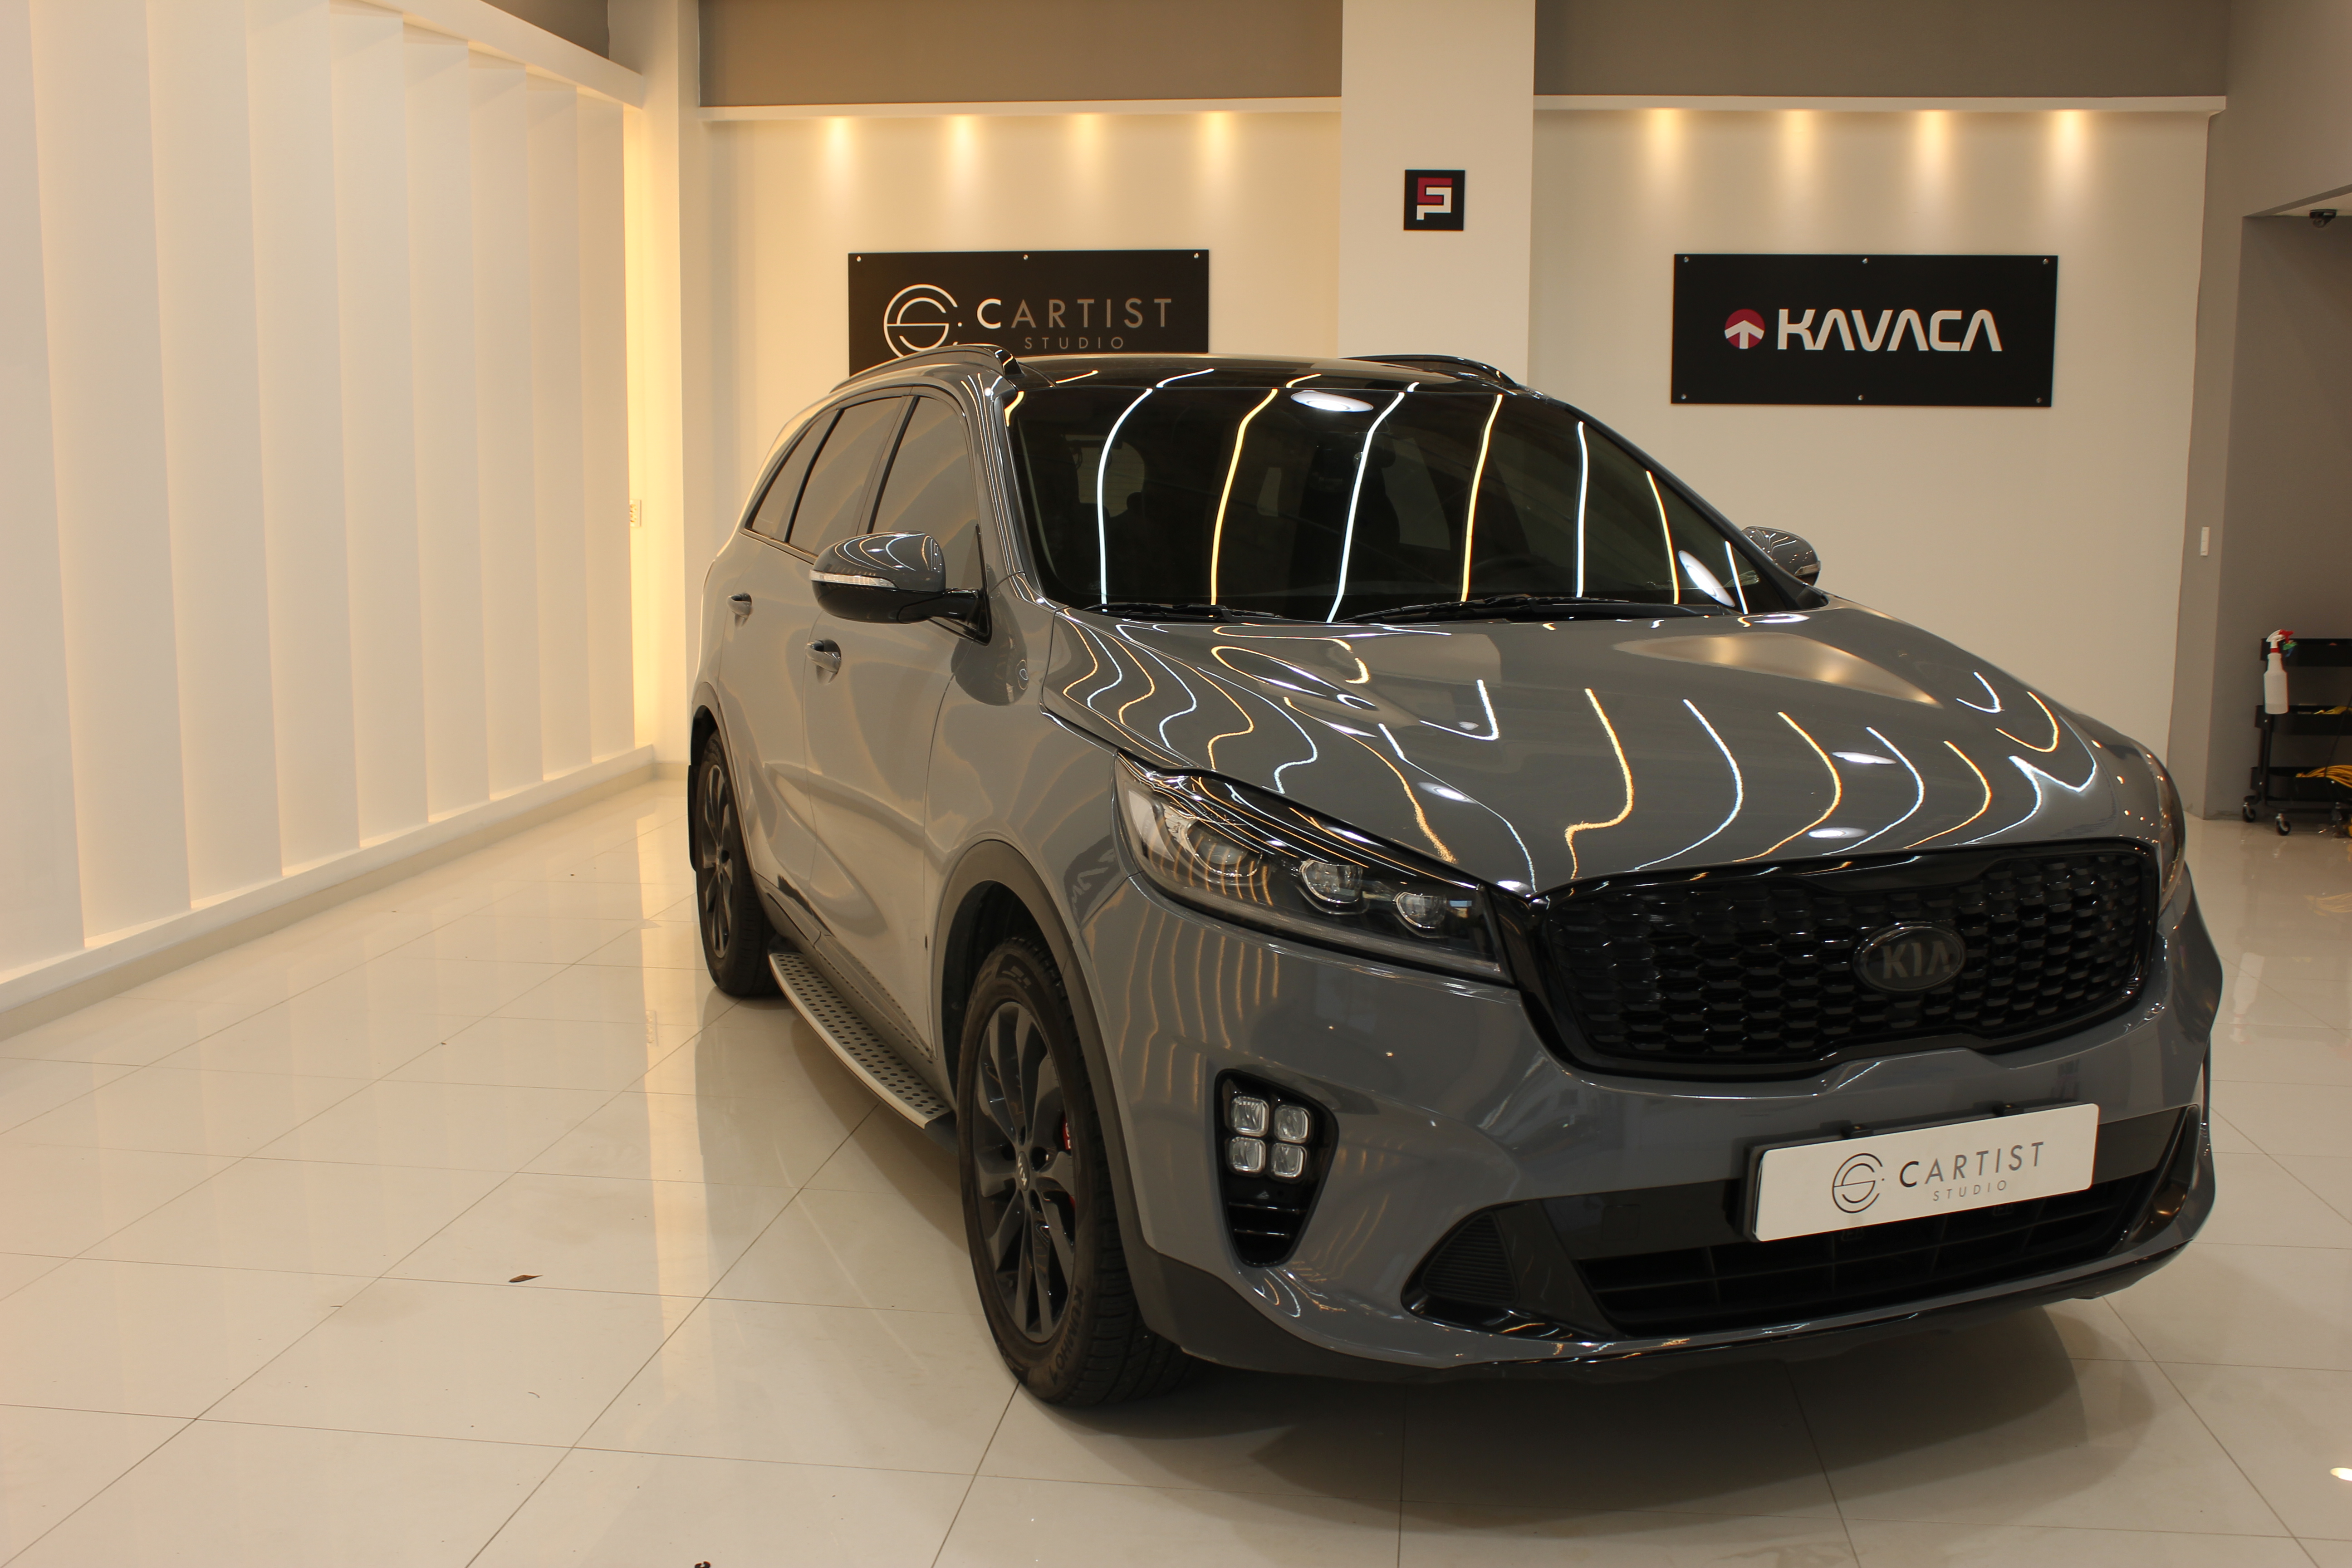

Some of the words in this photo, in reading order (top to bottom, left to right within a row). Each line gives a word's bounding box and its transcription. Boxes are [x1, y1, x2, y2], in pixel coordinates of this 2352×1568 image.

[977, 298, 1172, 329] CARTIST
[1778, 309, 2003, 352] KAVACA
[1024, 337, 1124, 350] STUDIO
[1882, 940, 1950, 979] KIA
[1899, 1142, 2044, 1188] CARTIST
[1933, 1180, 2007, 1201] STUDIO
[1056, 1285, 1083, 1370] KUMHO
